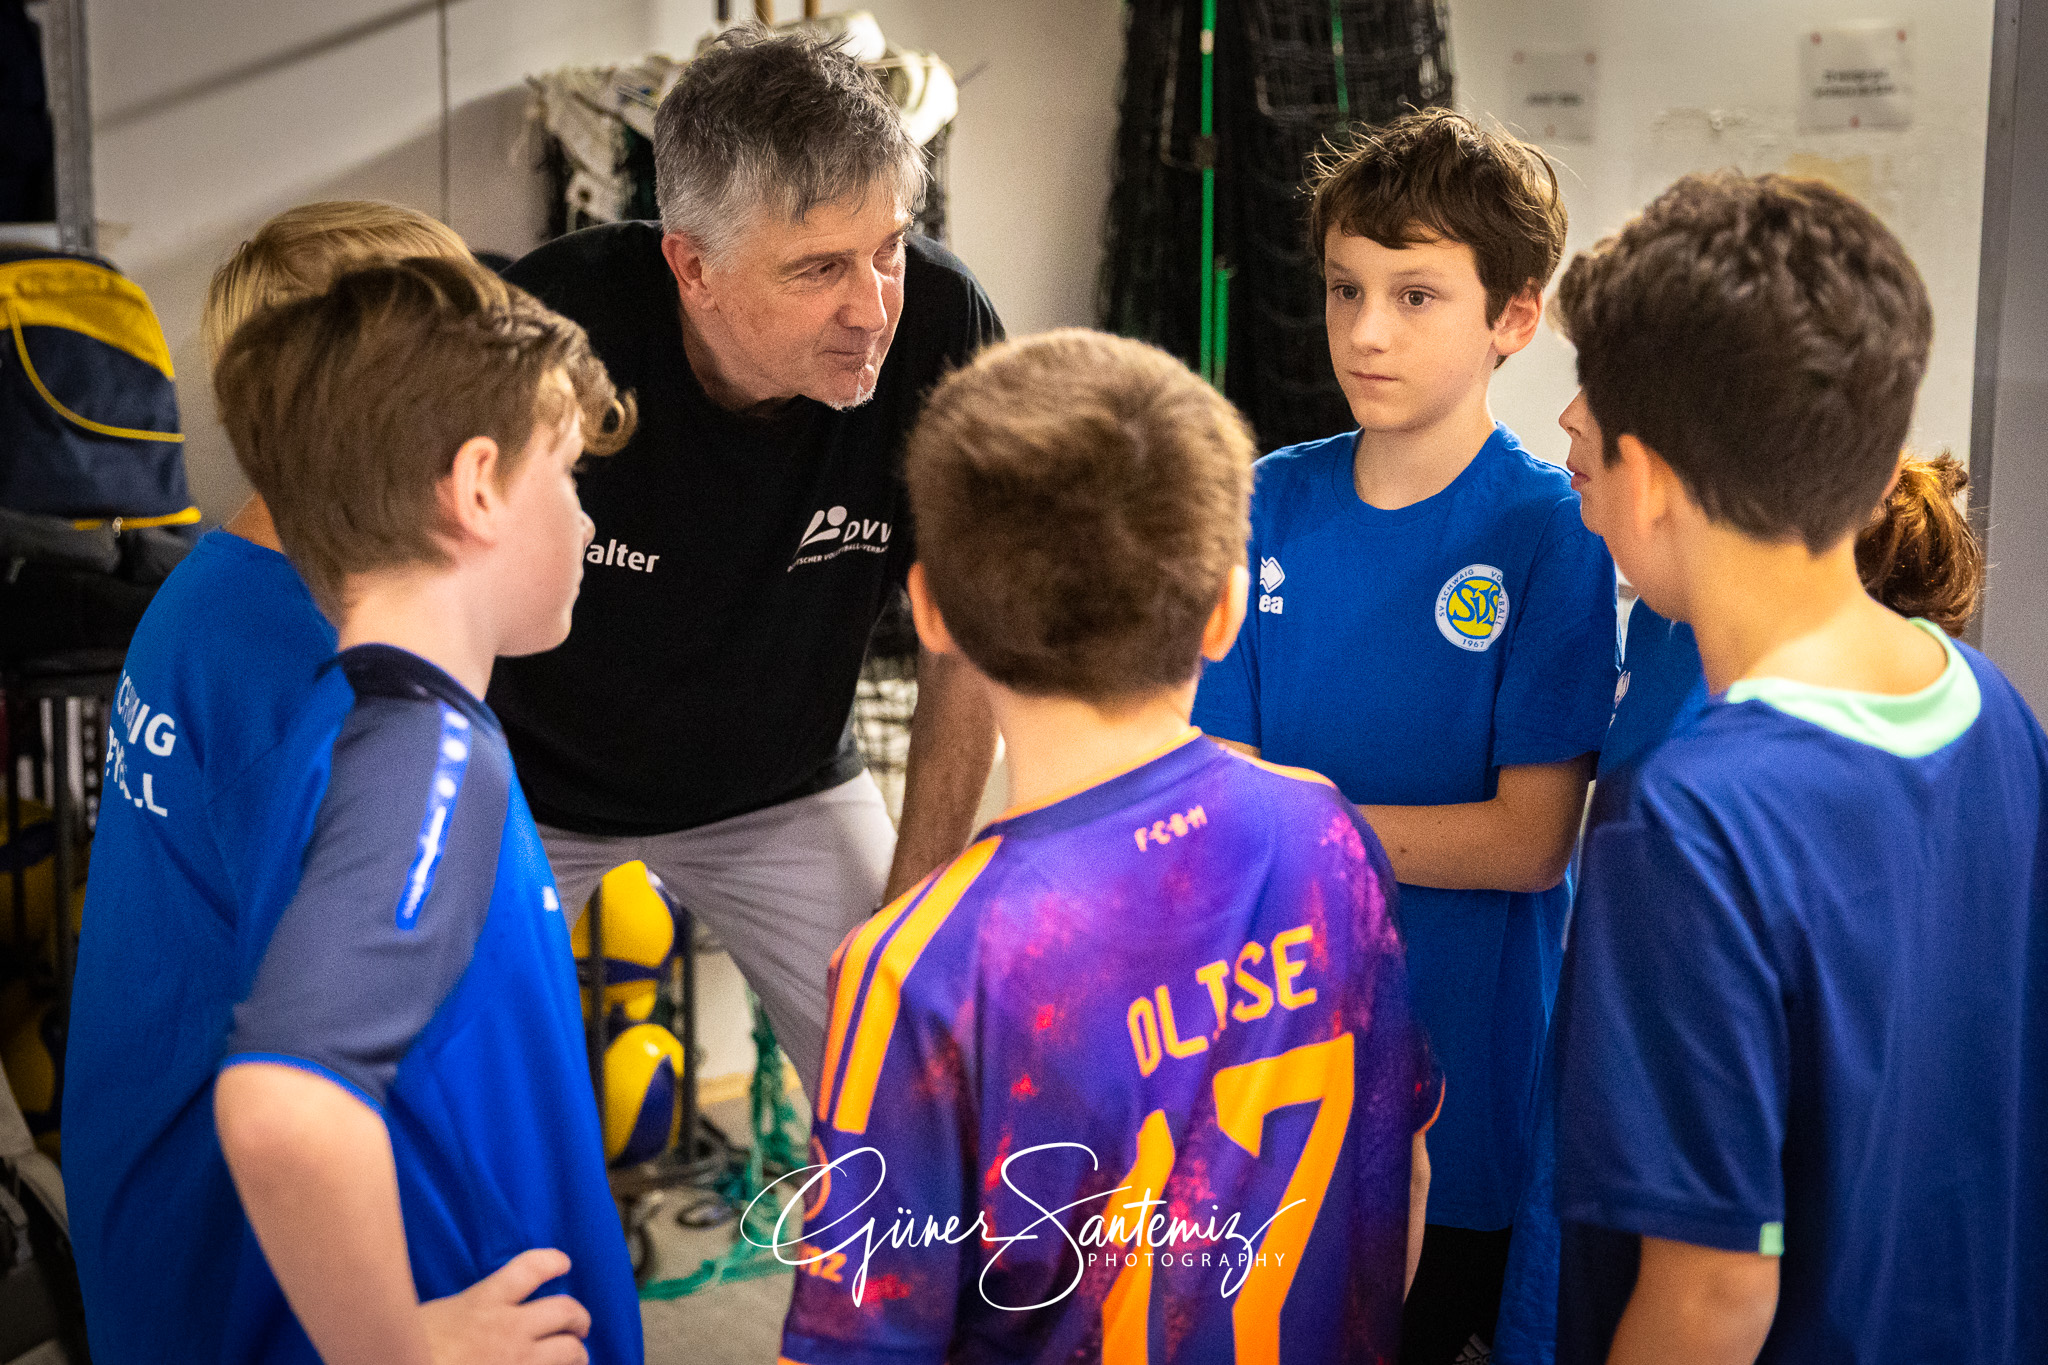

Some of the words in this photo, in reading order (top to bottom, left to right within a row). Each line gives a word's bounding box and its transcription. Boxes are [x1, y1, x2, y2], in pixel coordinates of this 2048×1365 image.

[584, 538, 660, 573] alter
[1441, 568, 1475, 602] SCHWAIG
[1462, 638, 1486, 648] 1967
[1101, 1031, 1355, 1365] 17
